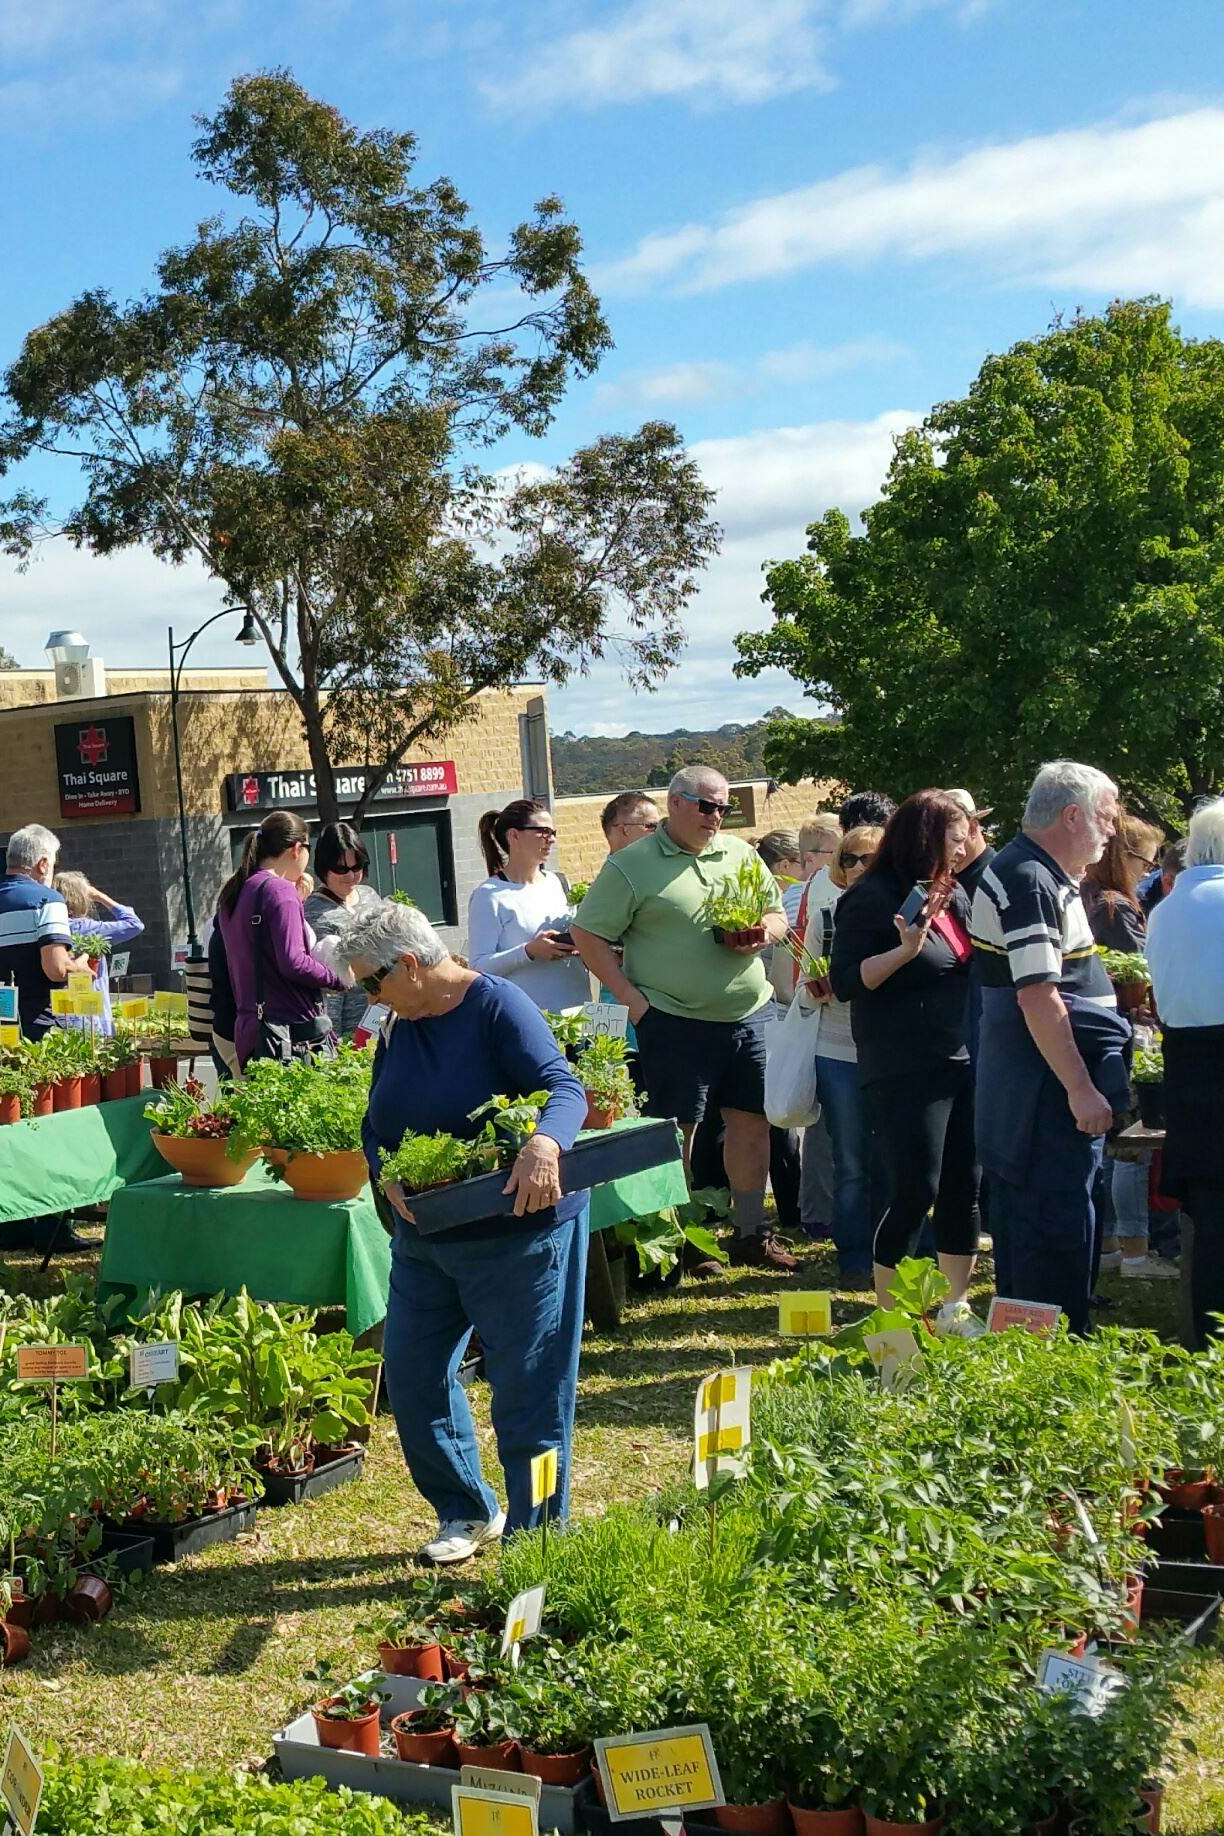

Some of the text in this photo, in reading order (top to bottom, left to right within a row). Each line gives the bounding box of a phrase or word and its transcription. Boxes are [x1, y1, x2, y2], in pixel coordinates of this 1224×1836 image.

[63, 771, 128, 786] Thai Square
[267, 774, 306, 798] Thai
[309, 774, 365, 796] Sare
[420, 766, 444, 782] 8899
[95, 799, 118, 807] Delivery
[585, 1004, 615, 1016] CAT
[620, 1761, 701, 1784] WIDE-LEAF
[635, 1780, 694, 1801] ROCKET
